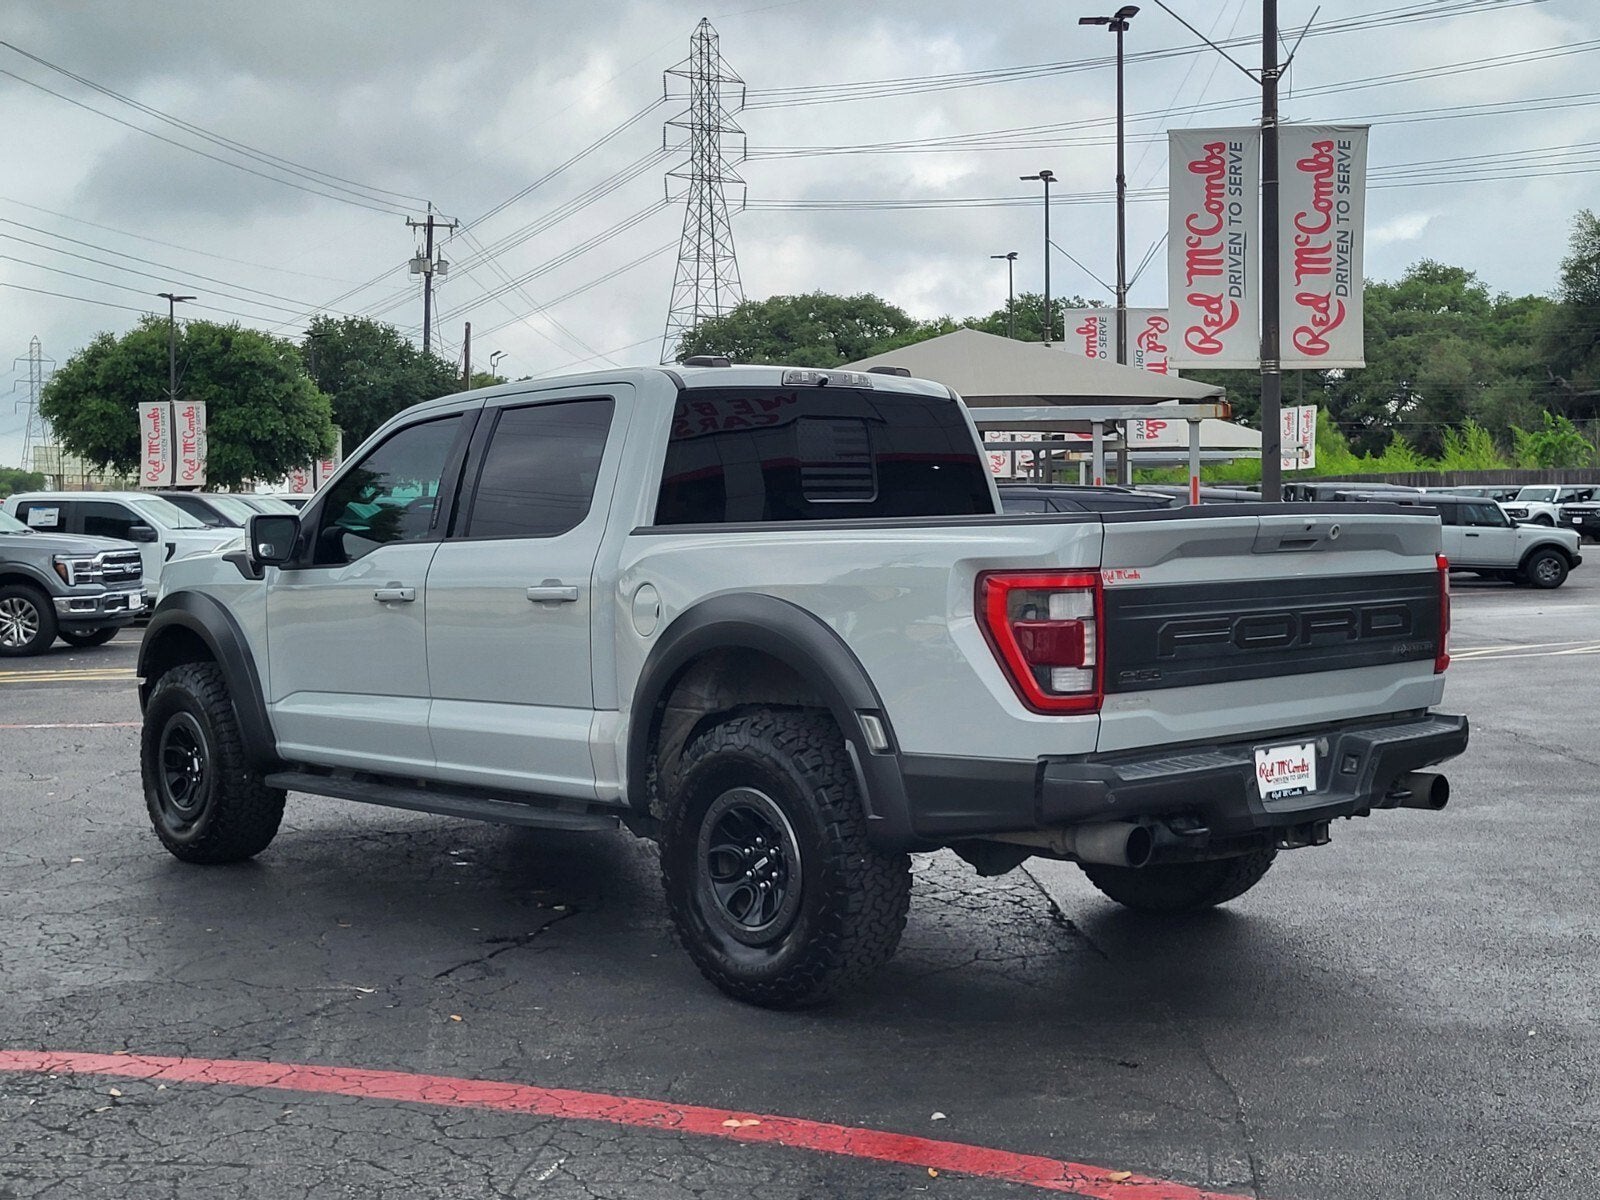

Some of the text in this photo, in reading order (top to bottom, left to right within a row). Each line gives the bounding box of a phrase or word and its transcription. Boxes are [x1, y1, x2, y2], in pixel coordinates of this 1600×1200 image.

[1228, 141, 1243, 299] DRIVEN TO SERVE
[1335, 139, 1351, 298] DRIVEN TO SERVE
[1184, 141, 1239, 356] Red McCombs
[1292, 140, 1346, 356] Red McCombs
[1075, 316, 1098, 358] ombs
[1098, 316, 1107, 348] SERVE
[1137, 315, 1170, 354] Red
[146, 407, 165, 482] Red McCombs
[160, 428, 166, 437] TO
[182, 406, 201, 481] Red McCombs
[196, 427, 202, 436] TO
[1135, 418, 1145, 440] RVE
[1156, 603, 1413, 659] FORD
[1259, 758, 1309, 783] Red McCombs
